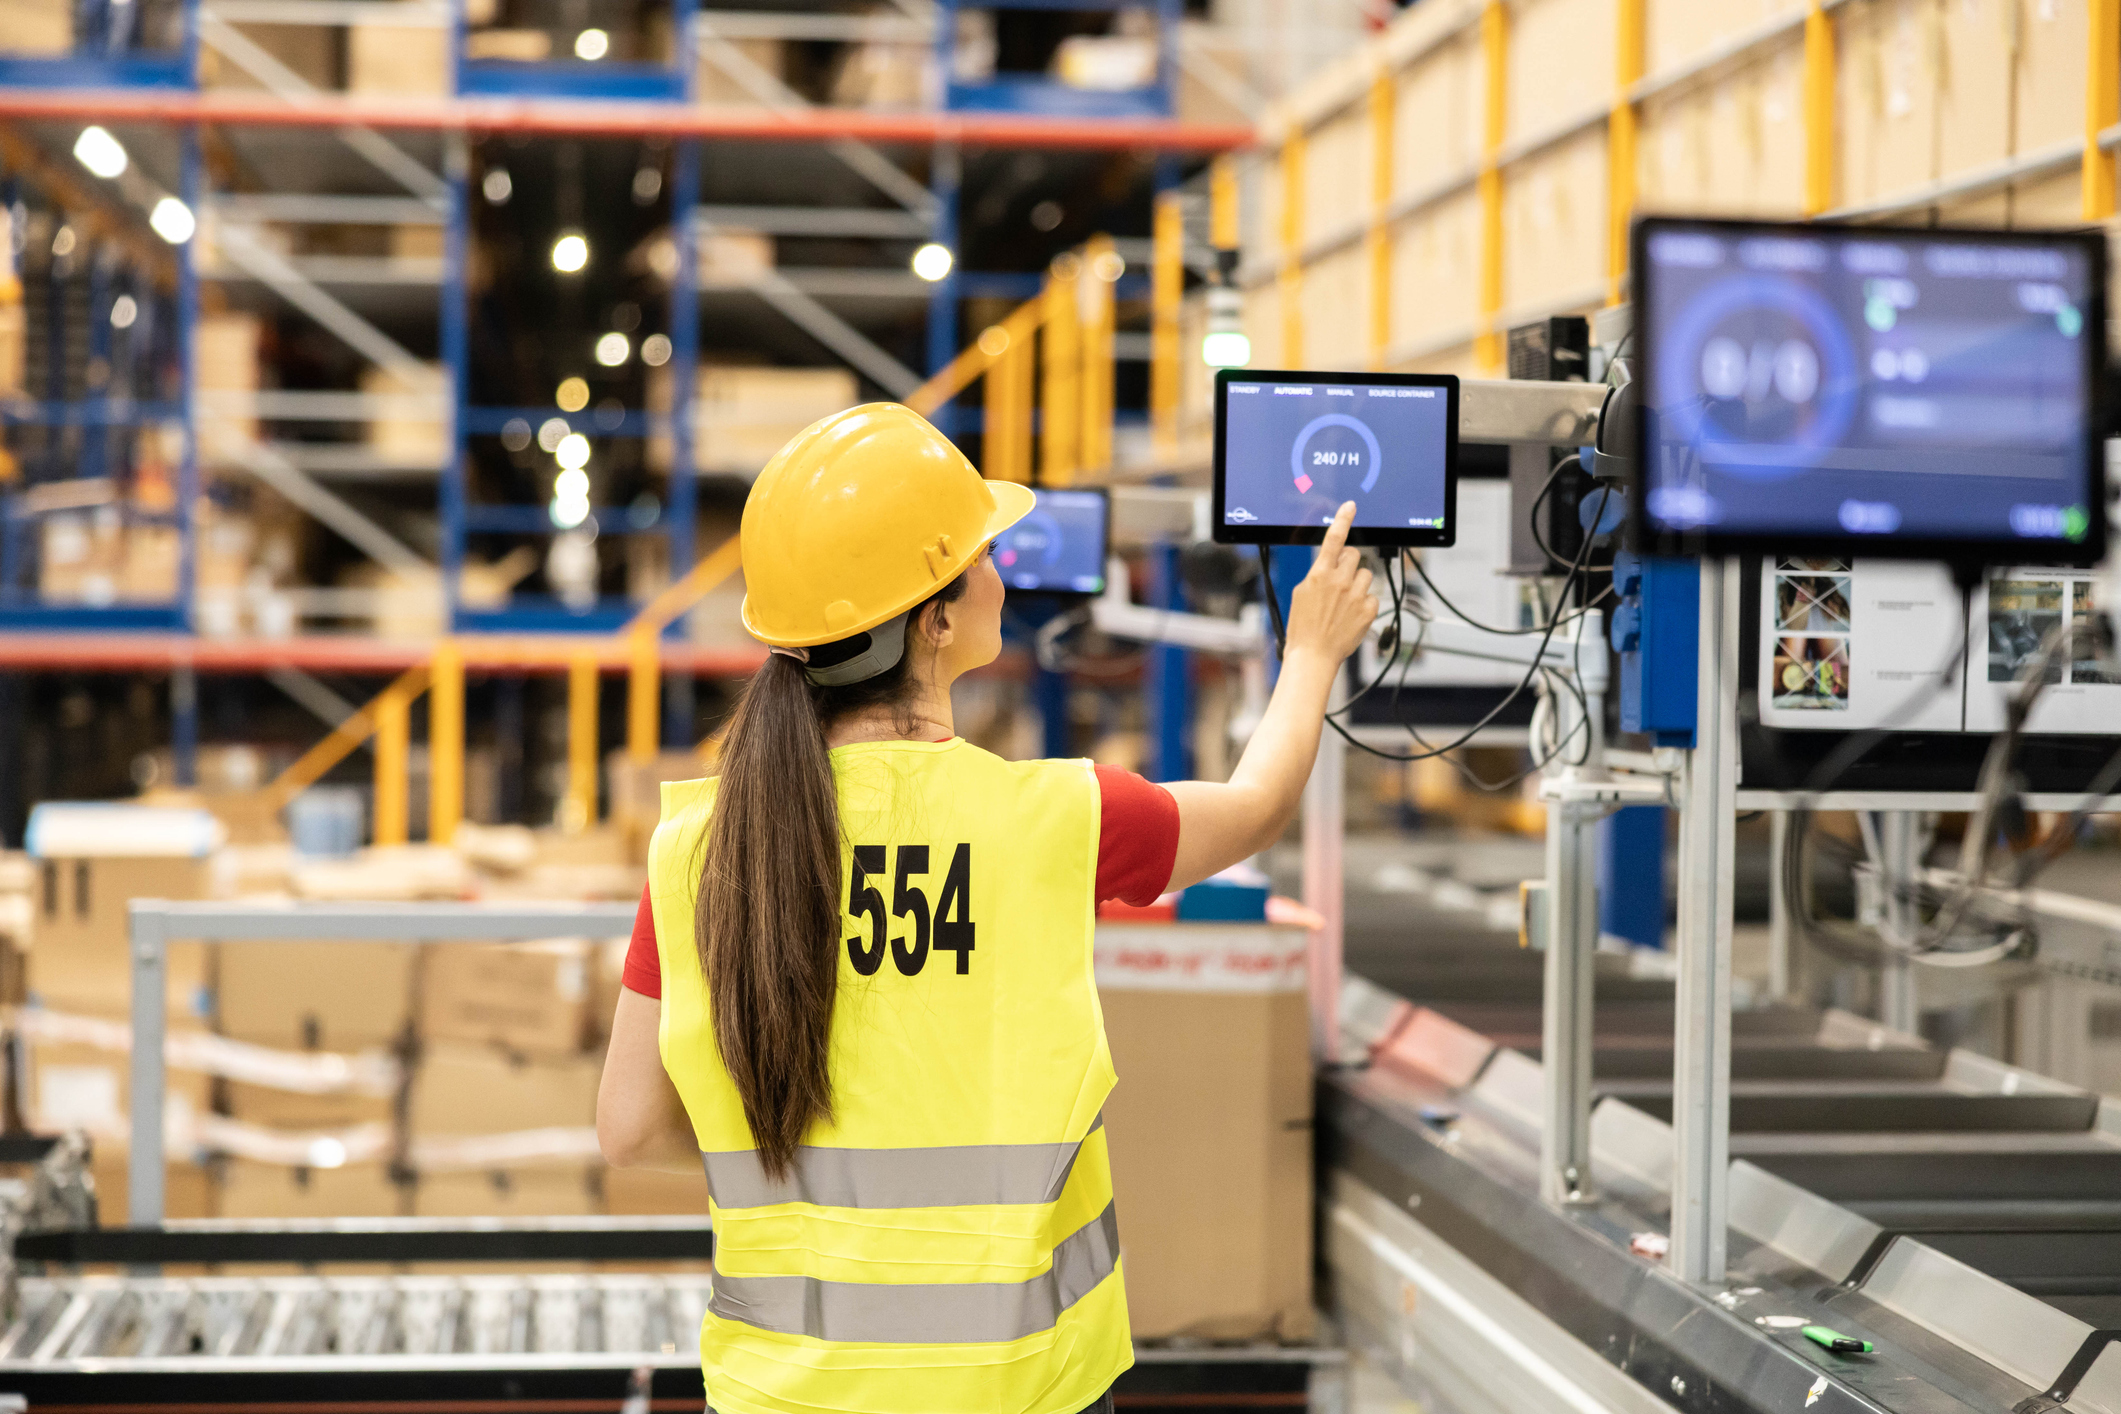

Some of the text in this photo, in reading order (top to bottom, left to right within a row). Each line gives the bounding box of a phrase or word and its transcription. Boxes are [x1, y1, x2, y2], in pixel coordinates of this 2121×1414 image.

[1229, 385, 1261, 395] STANDBY
[1273, 386, 1314, 396] AUTOMATIC
[1326, 387, 1355, 397] MANUAL
[1368, 388, 1435, 399] SOURCE CONTAINER
[1313, 451, 1360, 466] 240 / H
[839, 843, 976, 977] 554
